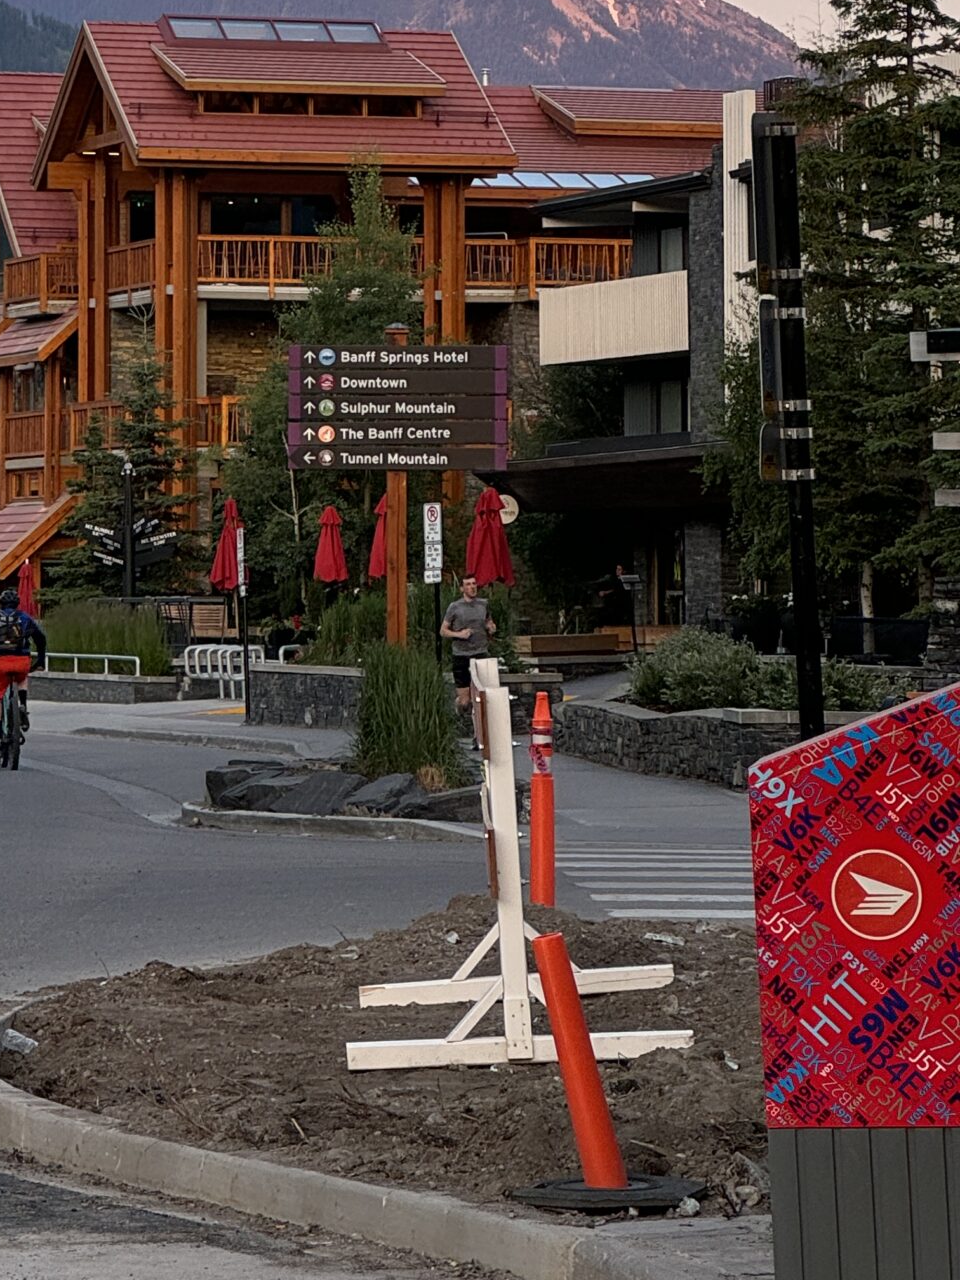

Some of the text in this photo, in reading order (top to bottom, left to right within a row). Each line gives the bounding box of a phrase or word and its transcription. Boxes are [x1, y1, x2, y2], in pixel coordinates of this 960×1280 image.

[341, 352, 468, 365] Banff Springs Hotel
[341, 377, 407, 388] Downtown
[341, 403, 455, 415] Sulphur Mountain
[341, 428, 450, 439] The Banff Centre
[341, 453, 448, 464] Tunnel Mountain
[811, 724, 880, 785] K4A
[900, 742, 944, 779] J6W
[918, 731, 956, 766] S4N
[854, 749, 887, 782] E3N
[886, 752, 931, 799] V7J
[748, 767, 805, 818] H9X
[792, 775, 833, 807] J6V
[839, 778, 887, 826] B4E
[875, 782, 913, 812] J5T
[773, 806, 822, 851] V6K
[825, 815, 853, 841] B2Z
[936, 830, 960, 856] A1B
[753, 832, 786, 874] X1A
[792, 835, 824, 865] V1X
[808, 847, 832, 872] S4N
[754, 871, 781, 900] E3N
[802, 886, 824, 912] V5A
[772, 880, 816, 927] V7J
[763, 912, 800, 941] J5T
[789, 921, 831, 956] V9L
[911, 933, 929, 953] K6H
[925, 928, 954, 955] V9L
[757, 946, 778, 968] P3Y
[841, 950, 869, 975] P3Y
[881, 948, 915, 980] T3M
[920, 942, 960, 989] V6K
[781, 953, 821, 997] T9K
[870, 977, 889, 995] B2J
[894, 969, 934, 1011] X1A
[767, 974, 805, 1016] T8N
[799, 970, 868, 1048] H1T
[848, 987, 909, 1053] M6S
[887, 1013, 920, 1049] E3N
[764, 1049, 794, 1083] E3N
[790, 1032, 828, 1075] T9K
[824, 1042, 866, 1073] J6V
[867, 1040, 928, 1100] B4E
[909, 1049, 946, 1079] J5T
[766, 1061, 809, 1103] K4A
[789, 1078, 817, 1118] J6W
[822, 1075, 852, 1106] B2Z
[866, 1076, 912, 1120] G3N
[847, 1093, 866, 1112] K6H
[926, 1091, 956, 1125] T9K
